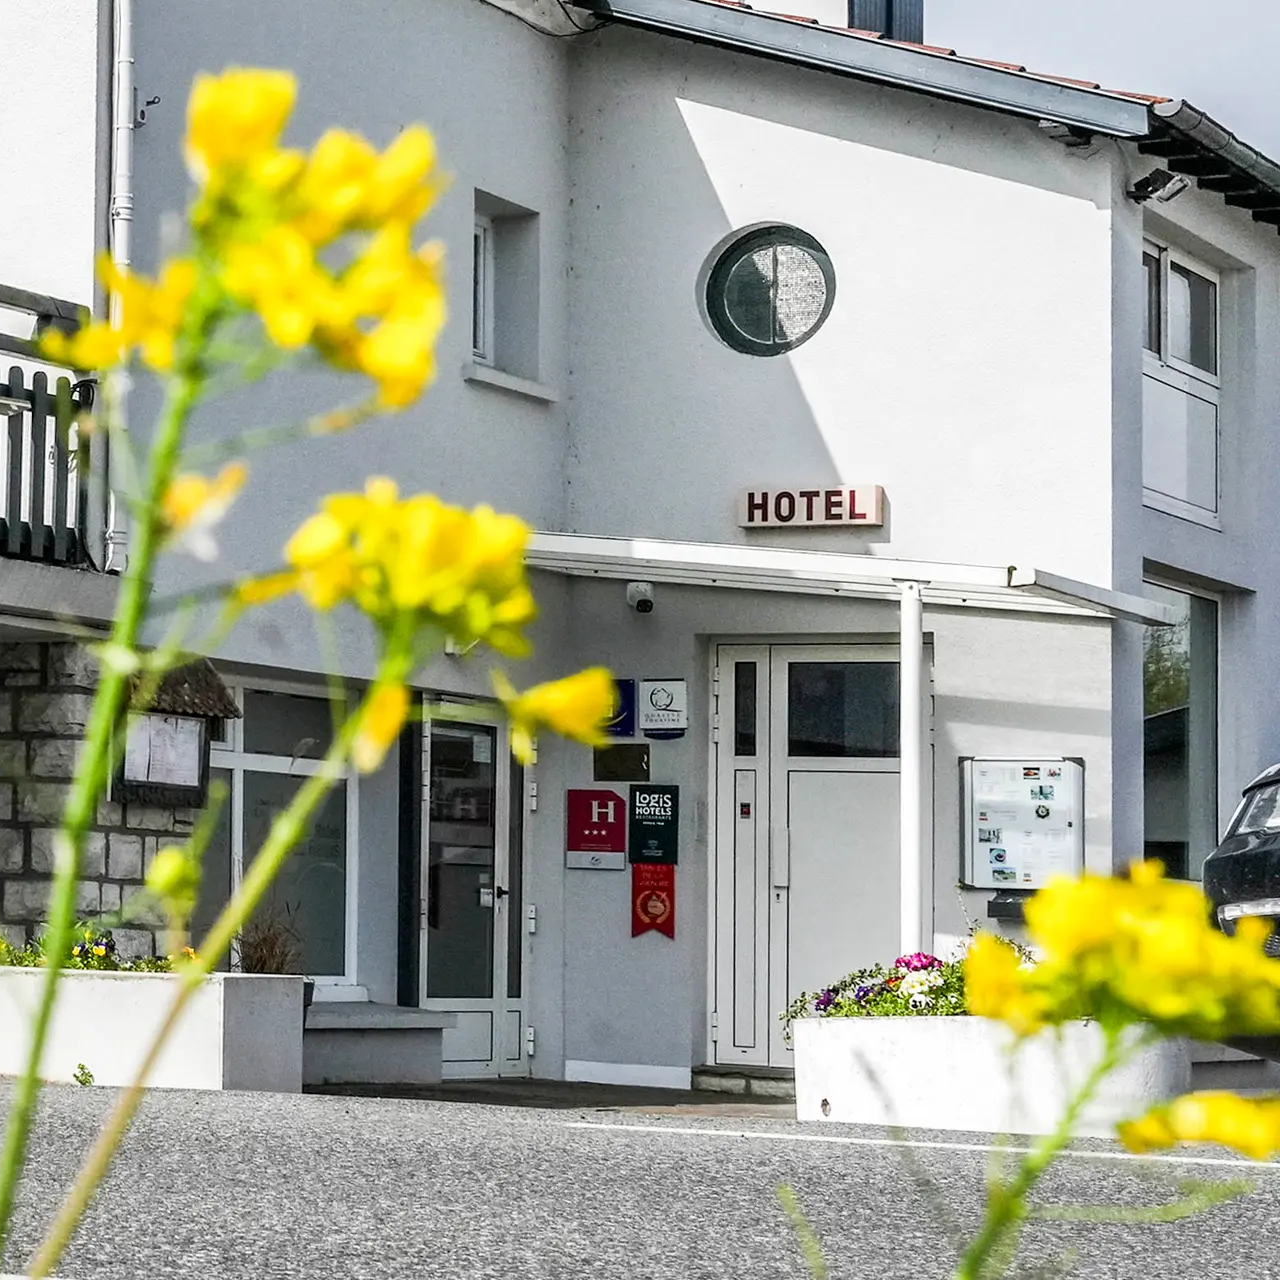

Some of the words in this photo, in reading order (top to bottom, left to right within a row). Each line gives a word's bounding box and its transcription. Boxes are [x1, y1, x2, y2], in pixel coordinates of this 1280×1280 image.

[748, 490, 867, 522] HOTEL
[590, 800, 616, 823] H
[635, 807, 672, 816] HOTELS
